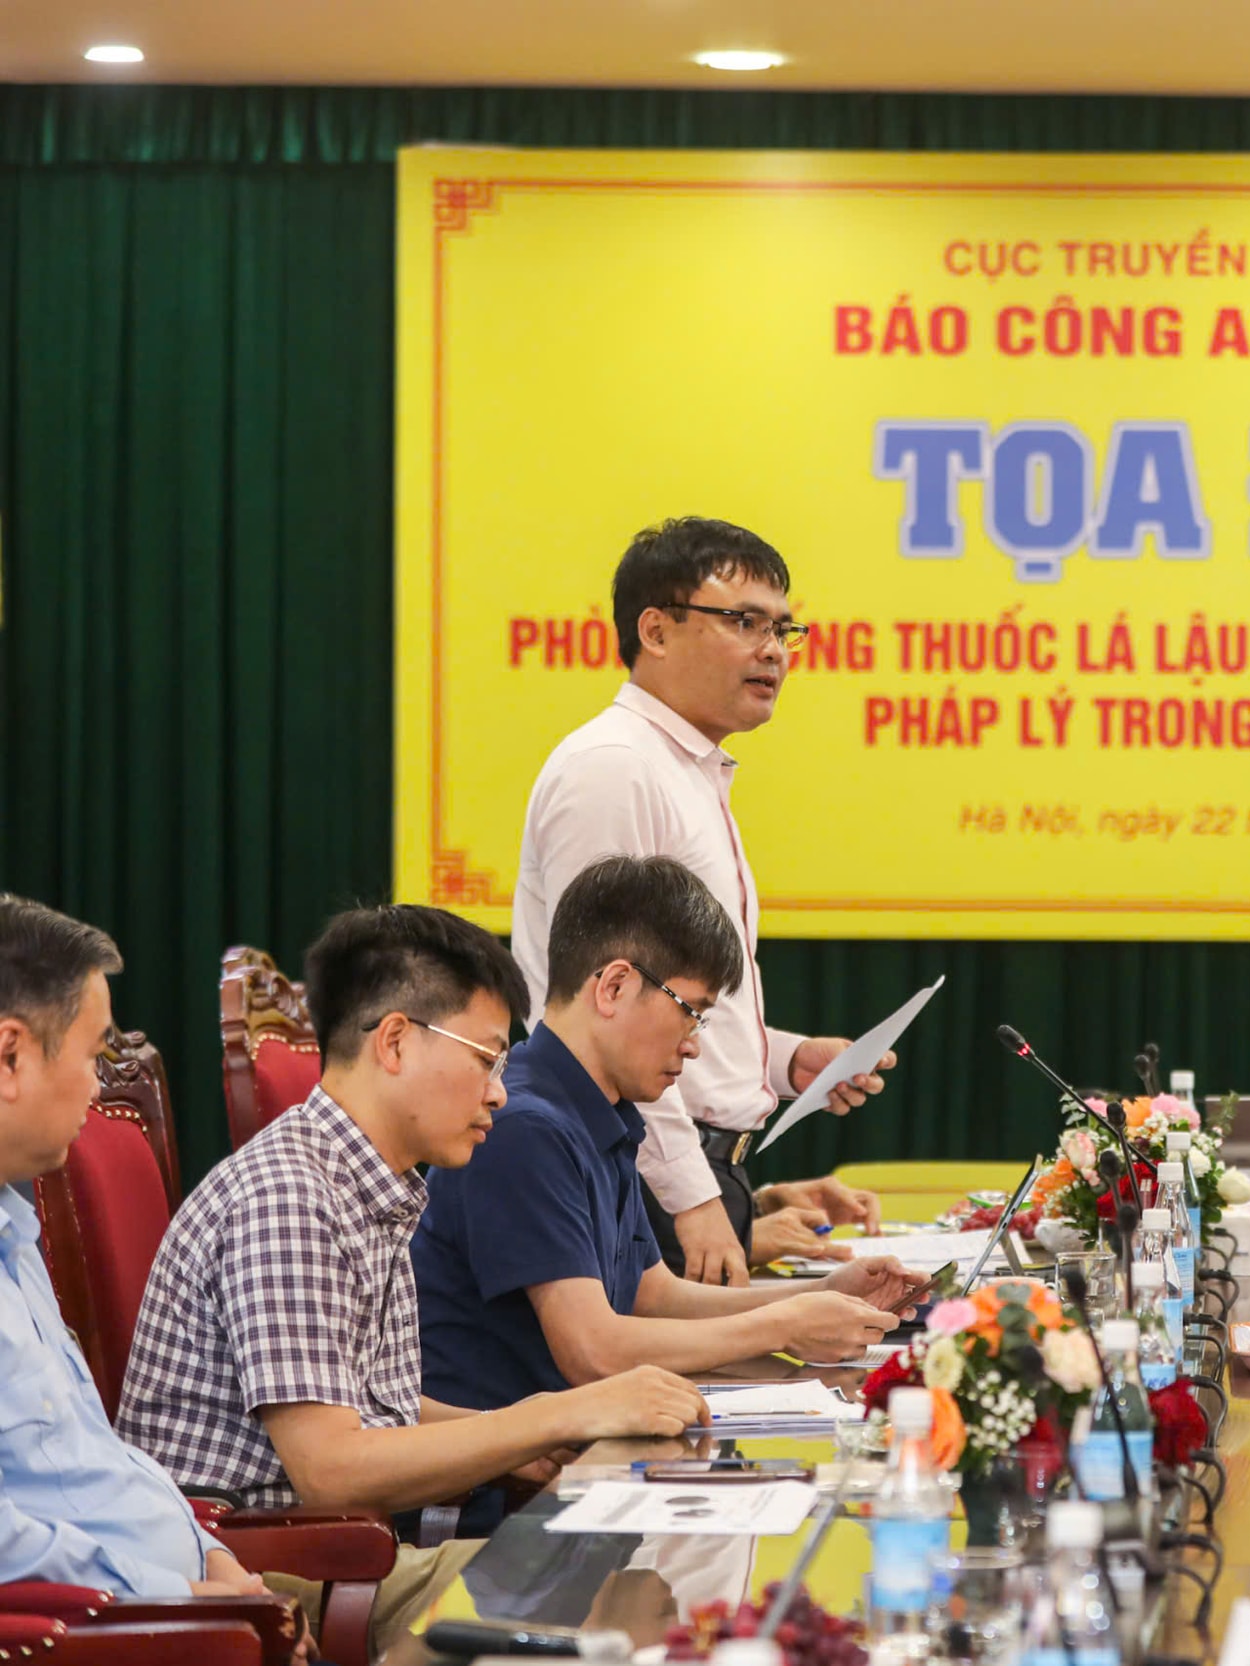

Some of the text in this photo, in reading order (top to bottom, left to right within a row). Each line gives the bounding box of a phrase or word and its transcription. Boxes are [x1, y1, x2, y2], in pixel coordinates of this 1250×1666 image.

[944, 240, 1041, 281] CỤC
[834, 293, 970, 356] BÁO
[995, 294, 1183, 357] CÔNG
[873, 419, 1212, 583] TỌA
[509, 604, 624, 670] PHÒ
[893, 600, 1064, 674] THUỐC
[1077, 610, 1137, 674] LÁ
[1154, 610, 1249, 687] LẬU
[863, 685, 1000, 747] PHÁP
[1019, 685, 1076, 748] LÝ
[1097, 803, 1184, 843] ngày
[1190, 804, 1238, 836] 22
